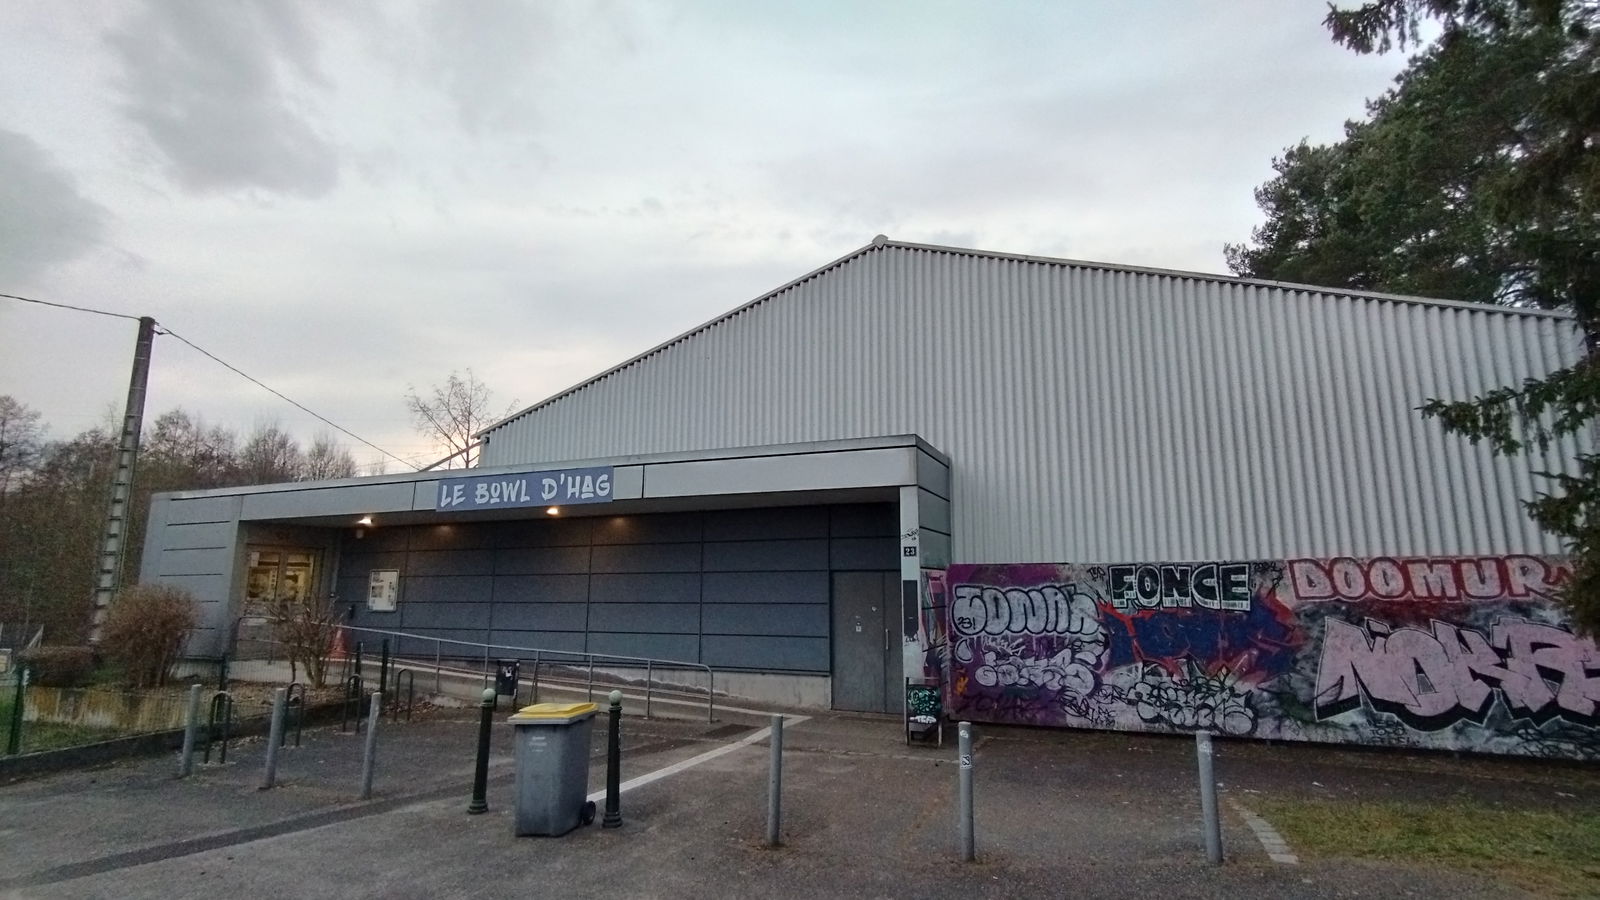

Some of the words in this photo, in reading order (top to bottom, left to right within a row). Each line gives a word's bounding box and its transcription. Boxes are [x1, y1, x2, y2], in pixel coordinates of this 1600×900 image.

[440, 484, 466, 508] LE
[475, 479, 530, 504] BOWL
[541, 473, 611, 501] D'HAG
[904, 546, 916, 556] 23
[1108, 563, 1250, 611] FONCE
